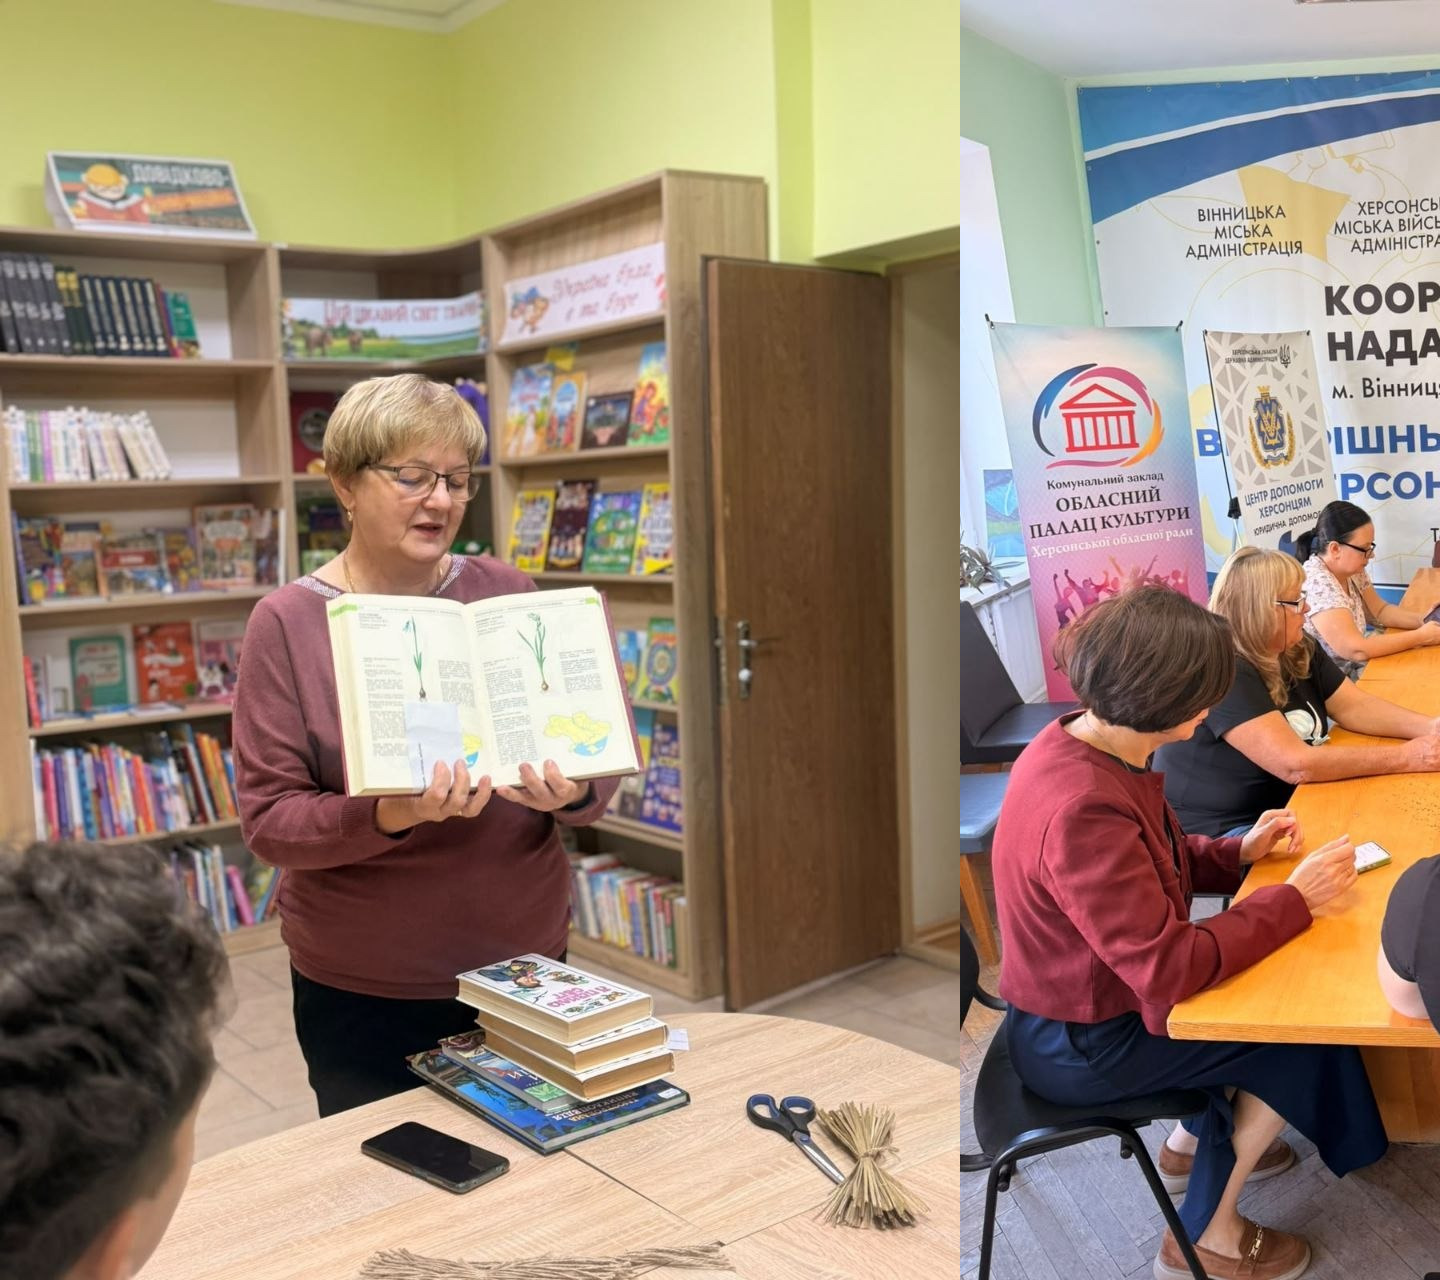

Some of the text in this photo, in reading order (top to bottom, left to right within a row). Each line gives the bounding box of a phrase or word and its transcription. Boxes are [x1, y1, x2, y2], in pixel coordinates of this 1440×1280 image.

[1197, 204, 1286, 223] ВІННИЦЬКА
[1214, 224, 1273, 240] МІСЬКА
[1334, 218, 1394, 236] МІСЬКА
[1185, 240, 1303, 260] АДМІНІСТРАЦІЯ
[1332, 383, 1354, 400] м.
[1046, 471, 1165, 492] Комунальний заклад
[1055, 487, 1162, 512] ОБЛАСНИЙ
[1244, 478, 1324, 506] ЦЕНТР ДОПОМОГИ
[1258, 496, 1312, 519] ХЕРСОНЦЯМ
[1029, 506, 1191, 540] ПАЛАЦ КУЛЬТУРИ
[1253, 520, 1287, 536] ЮРИДИЧНА
[1031, 526, 1194, 559] Херсонської обласної ради
